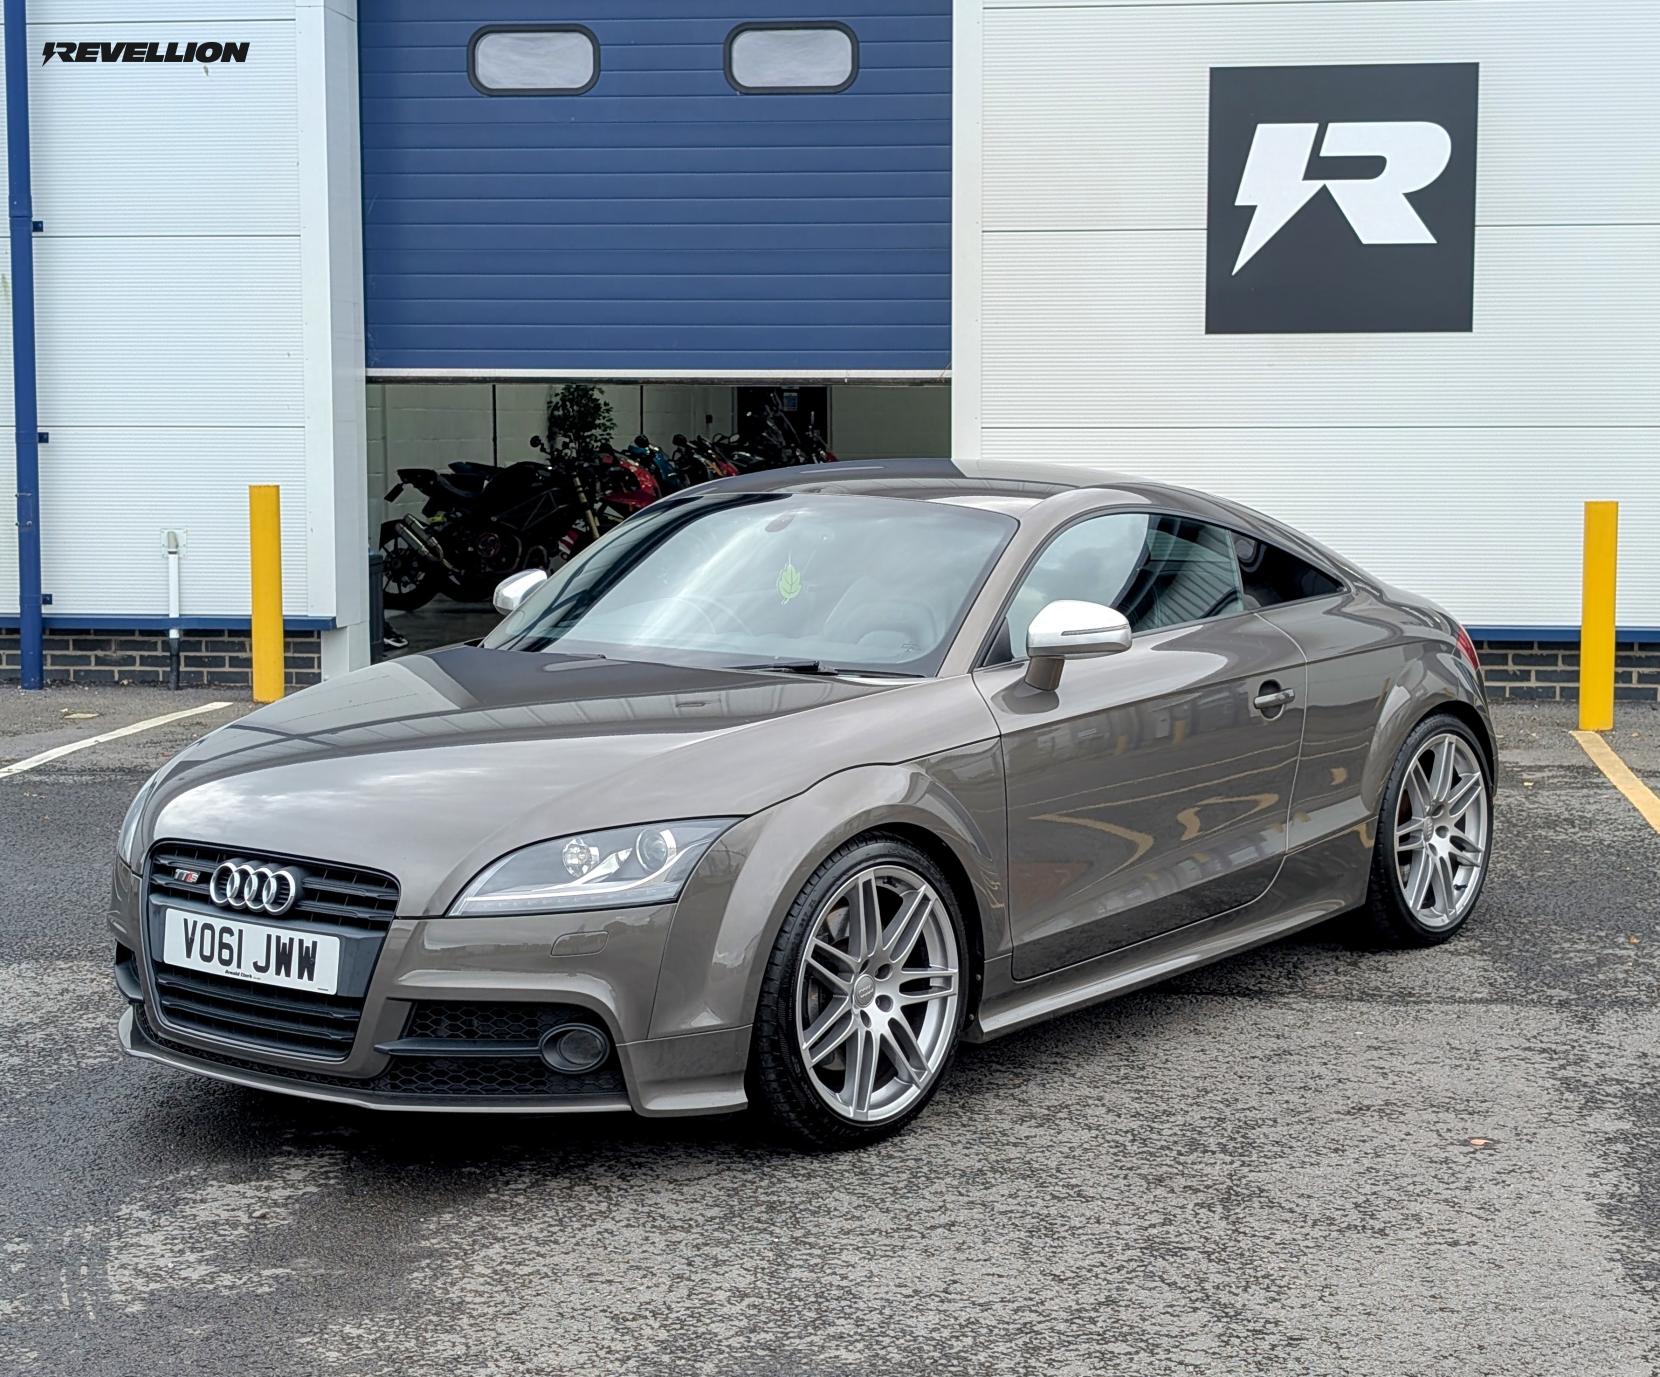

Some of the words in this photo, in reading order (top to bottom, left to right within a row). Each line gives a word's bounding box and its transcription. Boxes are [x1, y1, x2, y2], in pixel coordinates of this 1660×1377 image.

[1232, 121, 1452, 276] R
[174, 869, 199, 883] TTS
[183, 918, 243, 969] VO61
[252, 933, 318, 982] JWW
